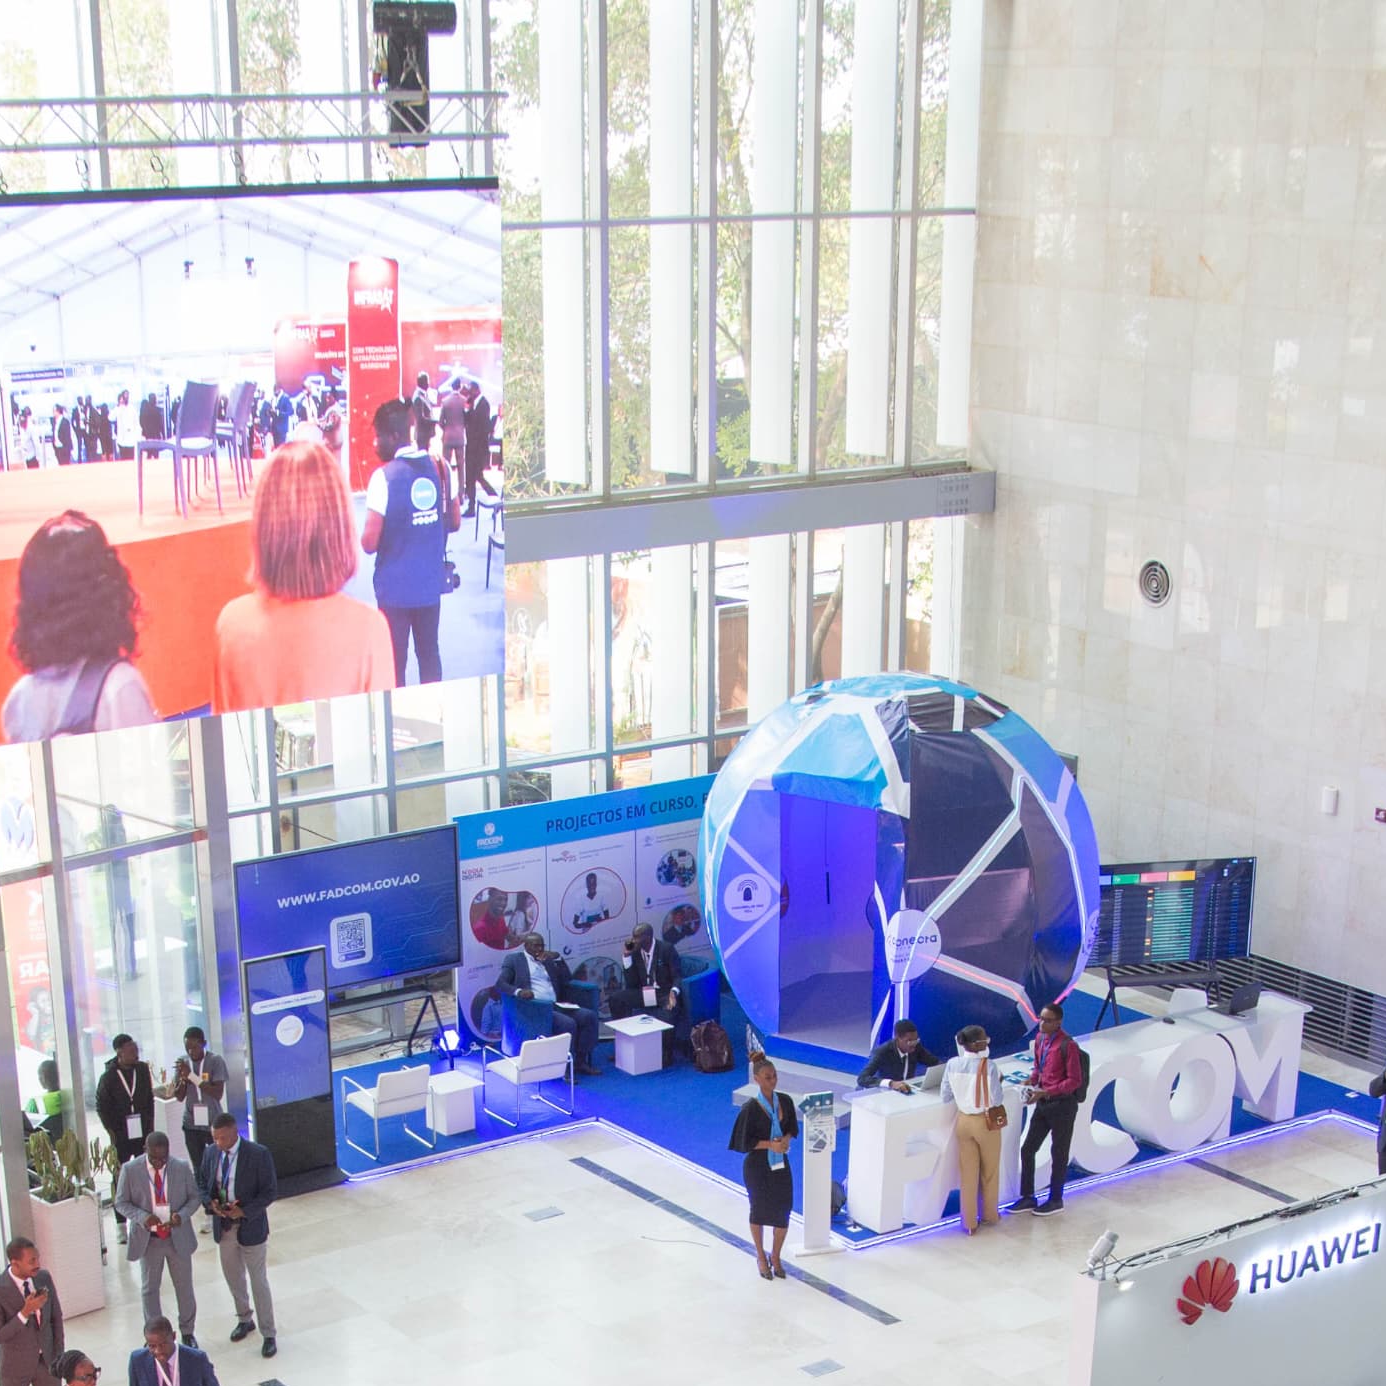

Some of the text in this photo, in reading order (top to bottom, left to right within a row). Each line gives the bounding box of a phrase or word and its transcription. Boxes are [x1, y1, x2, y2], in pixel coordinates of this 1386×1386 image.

[546, 795, 698, 833] PROJECTOS EM CURSO,
[277, 873, 420, 909] WWW.FADCOM.GOV.AO
[1249, 1222, 1383, 1294] HUAWEI
